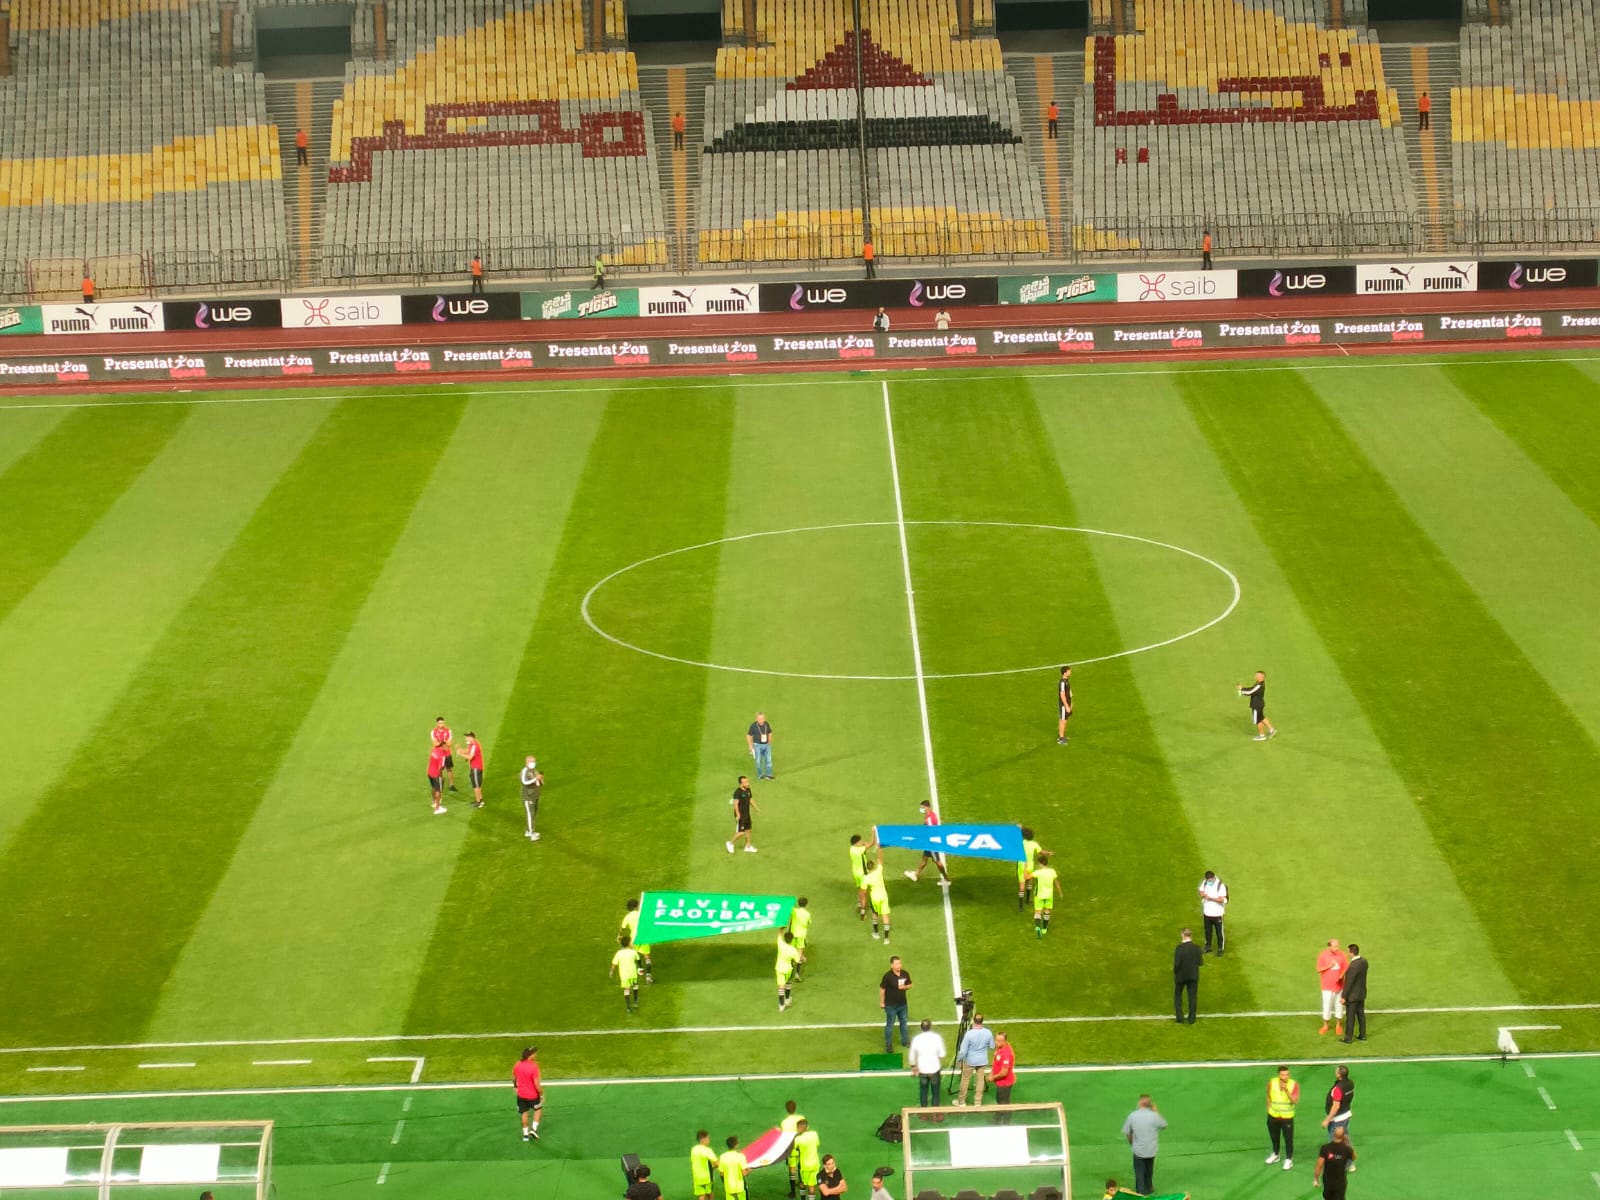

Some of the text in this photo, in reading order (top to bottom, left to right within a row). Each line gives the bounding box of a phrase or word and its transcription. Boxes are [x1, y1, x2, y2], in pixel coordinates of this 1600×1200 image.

[328, 98, 647, 183] مصر
[1056, 279, 1096, 302] TIGER
[1170, 275, 1216, 296] saib
[1365, 278, 1404, 292] PUMA
[1423, 276, 1462, 290] PUMA
[334, 301, 380, 321] saib
[578, 294, 617, 317] TIGER
[648, 301, 687, 314] PUMA
[706, 299, 744, 312] PUMA
[52, 319, 90, 331] PUMA
[110, 317, 148, 330] PUMA
[1219, 320, 1321, 337] Presentation
[1334, 319, 1424, 334] Presentation
[1440, 313, 1542, 330] Presentation
[888, 333, 977, 348] Presentation
[993, 328, 1094, 344] Presentation
[1113, 327, 1203, 341] Presentation
[548, 341, 649, 357] Presentation
[668, 340, 757, 355] Presentation
[773, 334, 875, 351] Presentation
[223, 354, 313, 368] Presentation
[328, 348, 430, 364] Presentation
[443, 347, 532, 362] Presentation
[0, 360, 88, 375] Presentation
[103, 354, 205, 371] Presentation
